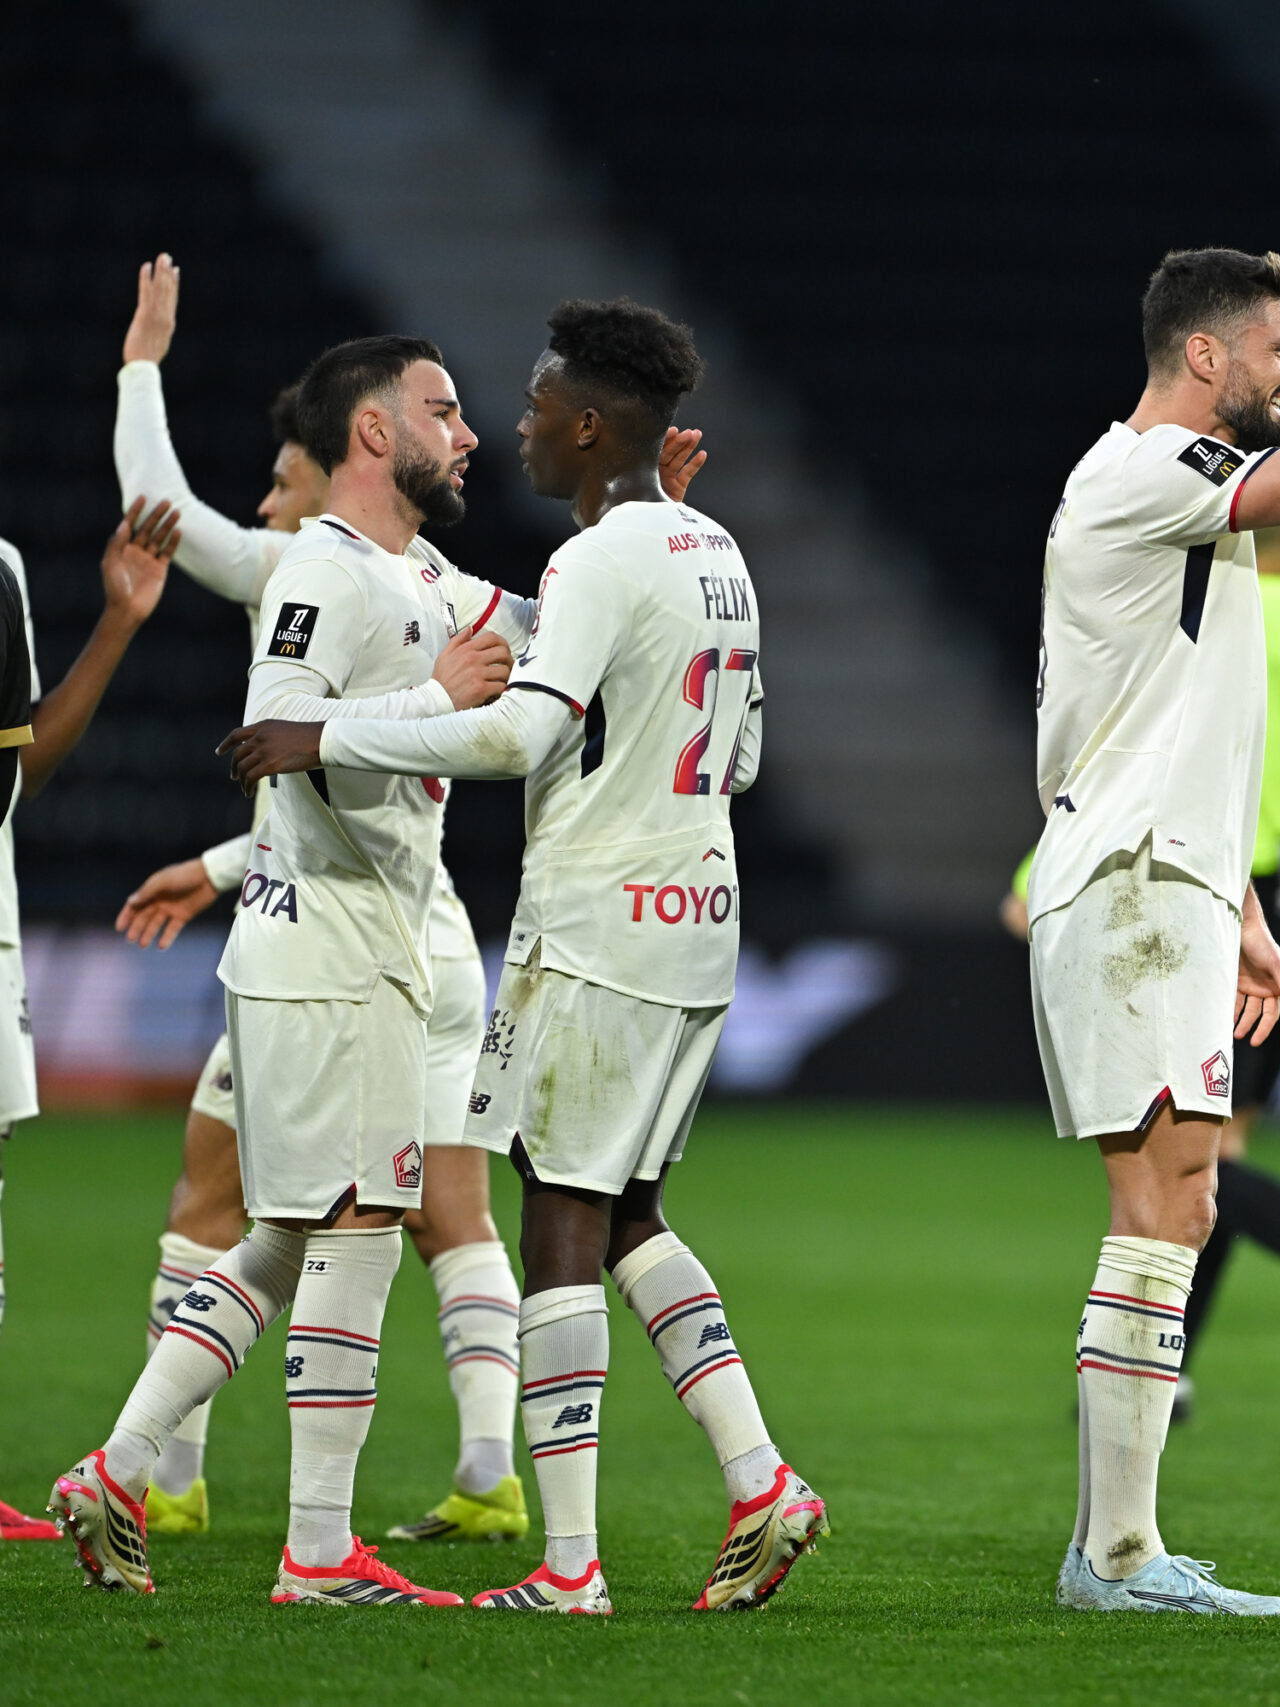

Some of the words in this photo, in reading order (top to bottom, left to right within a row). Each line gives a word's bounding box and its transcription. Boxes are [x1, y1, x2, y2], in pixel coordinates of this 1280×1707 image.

[1202, 451, 1226, 475] LIGUE
[699, 568, 751, 622] FÉLIX
[276, 630, 303, 643] LIGUE
[672, 647, 758, 796] 27
[241, 868, 298, 924] OTA
[307, 1260, 326, 1272] 74
